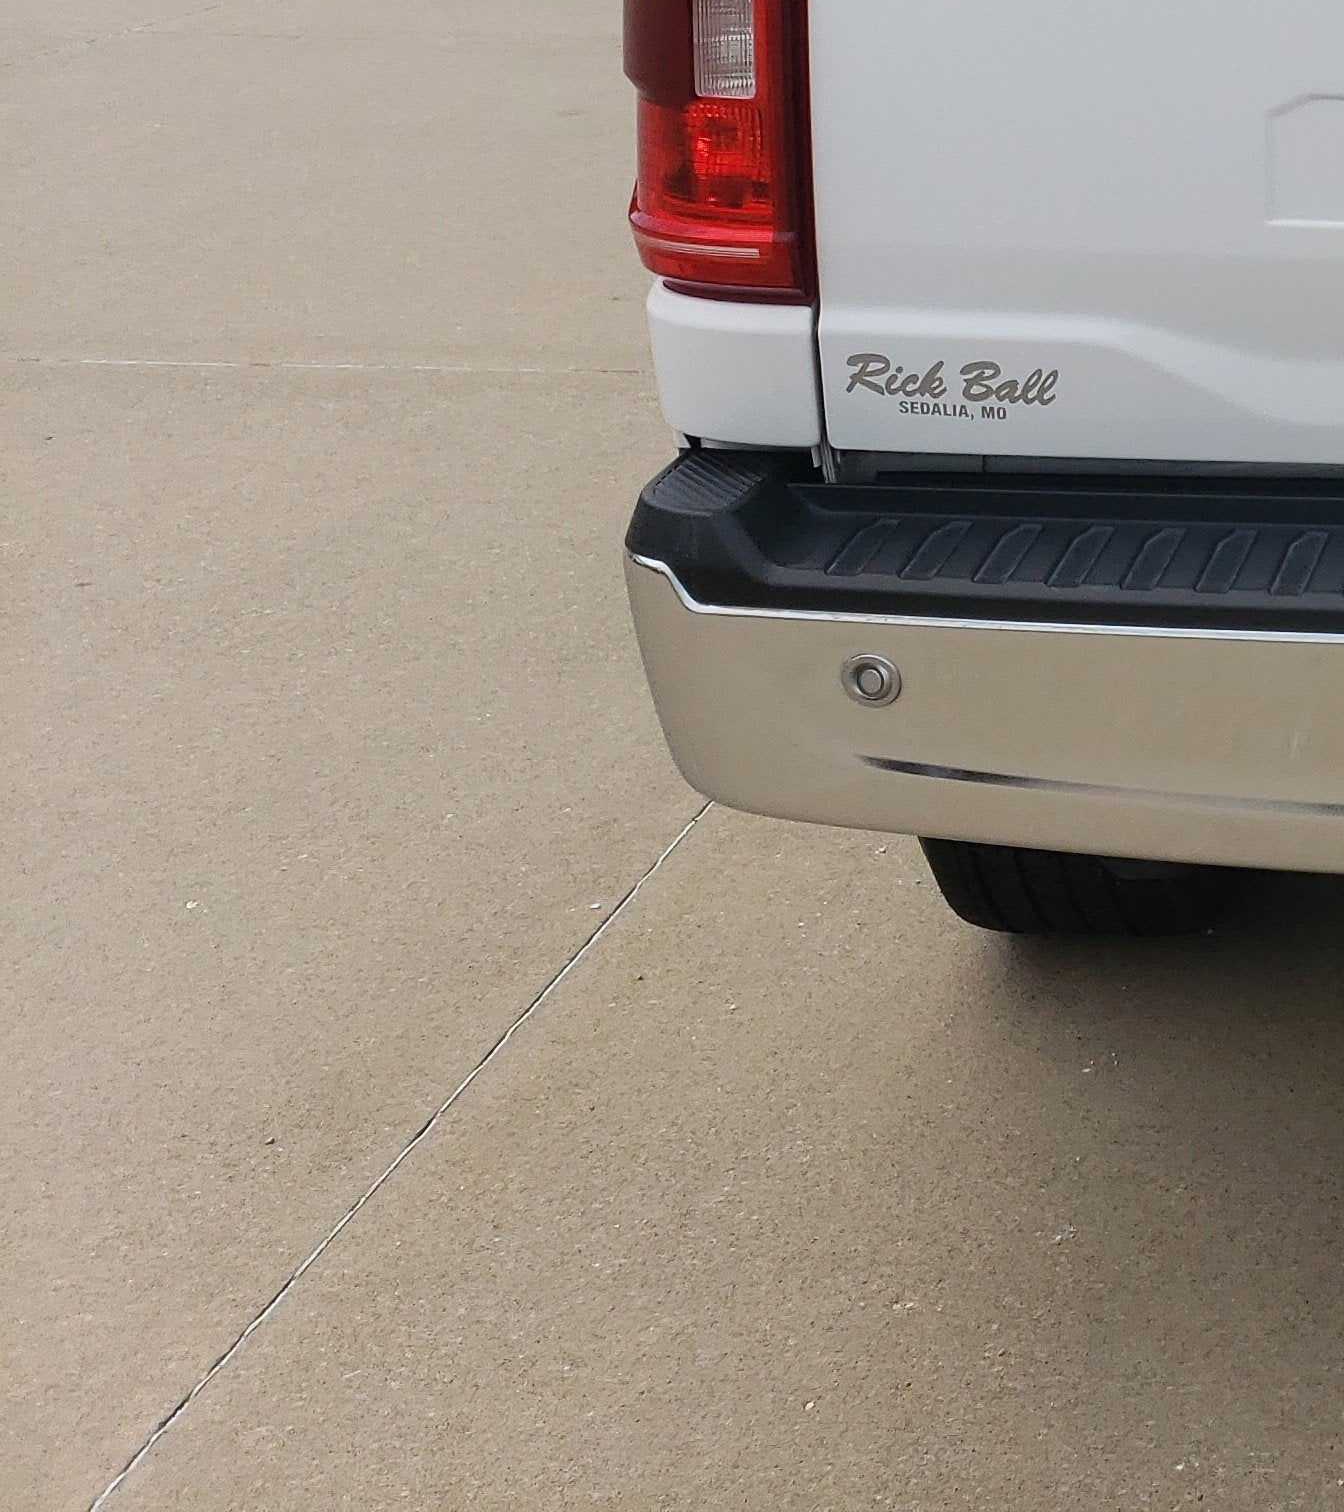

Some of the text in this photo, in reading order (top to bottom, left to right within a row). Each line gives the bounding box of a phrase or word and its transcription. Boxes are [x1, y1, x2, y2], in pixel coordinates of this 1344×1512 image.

[846, 352, 1059, 406] Rick Ball
[899, 400, 1007, 421] SEDALIA, MO
